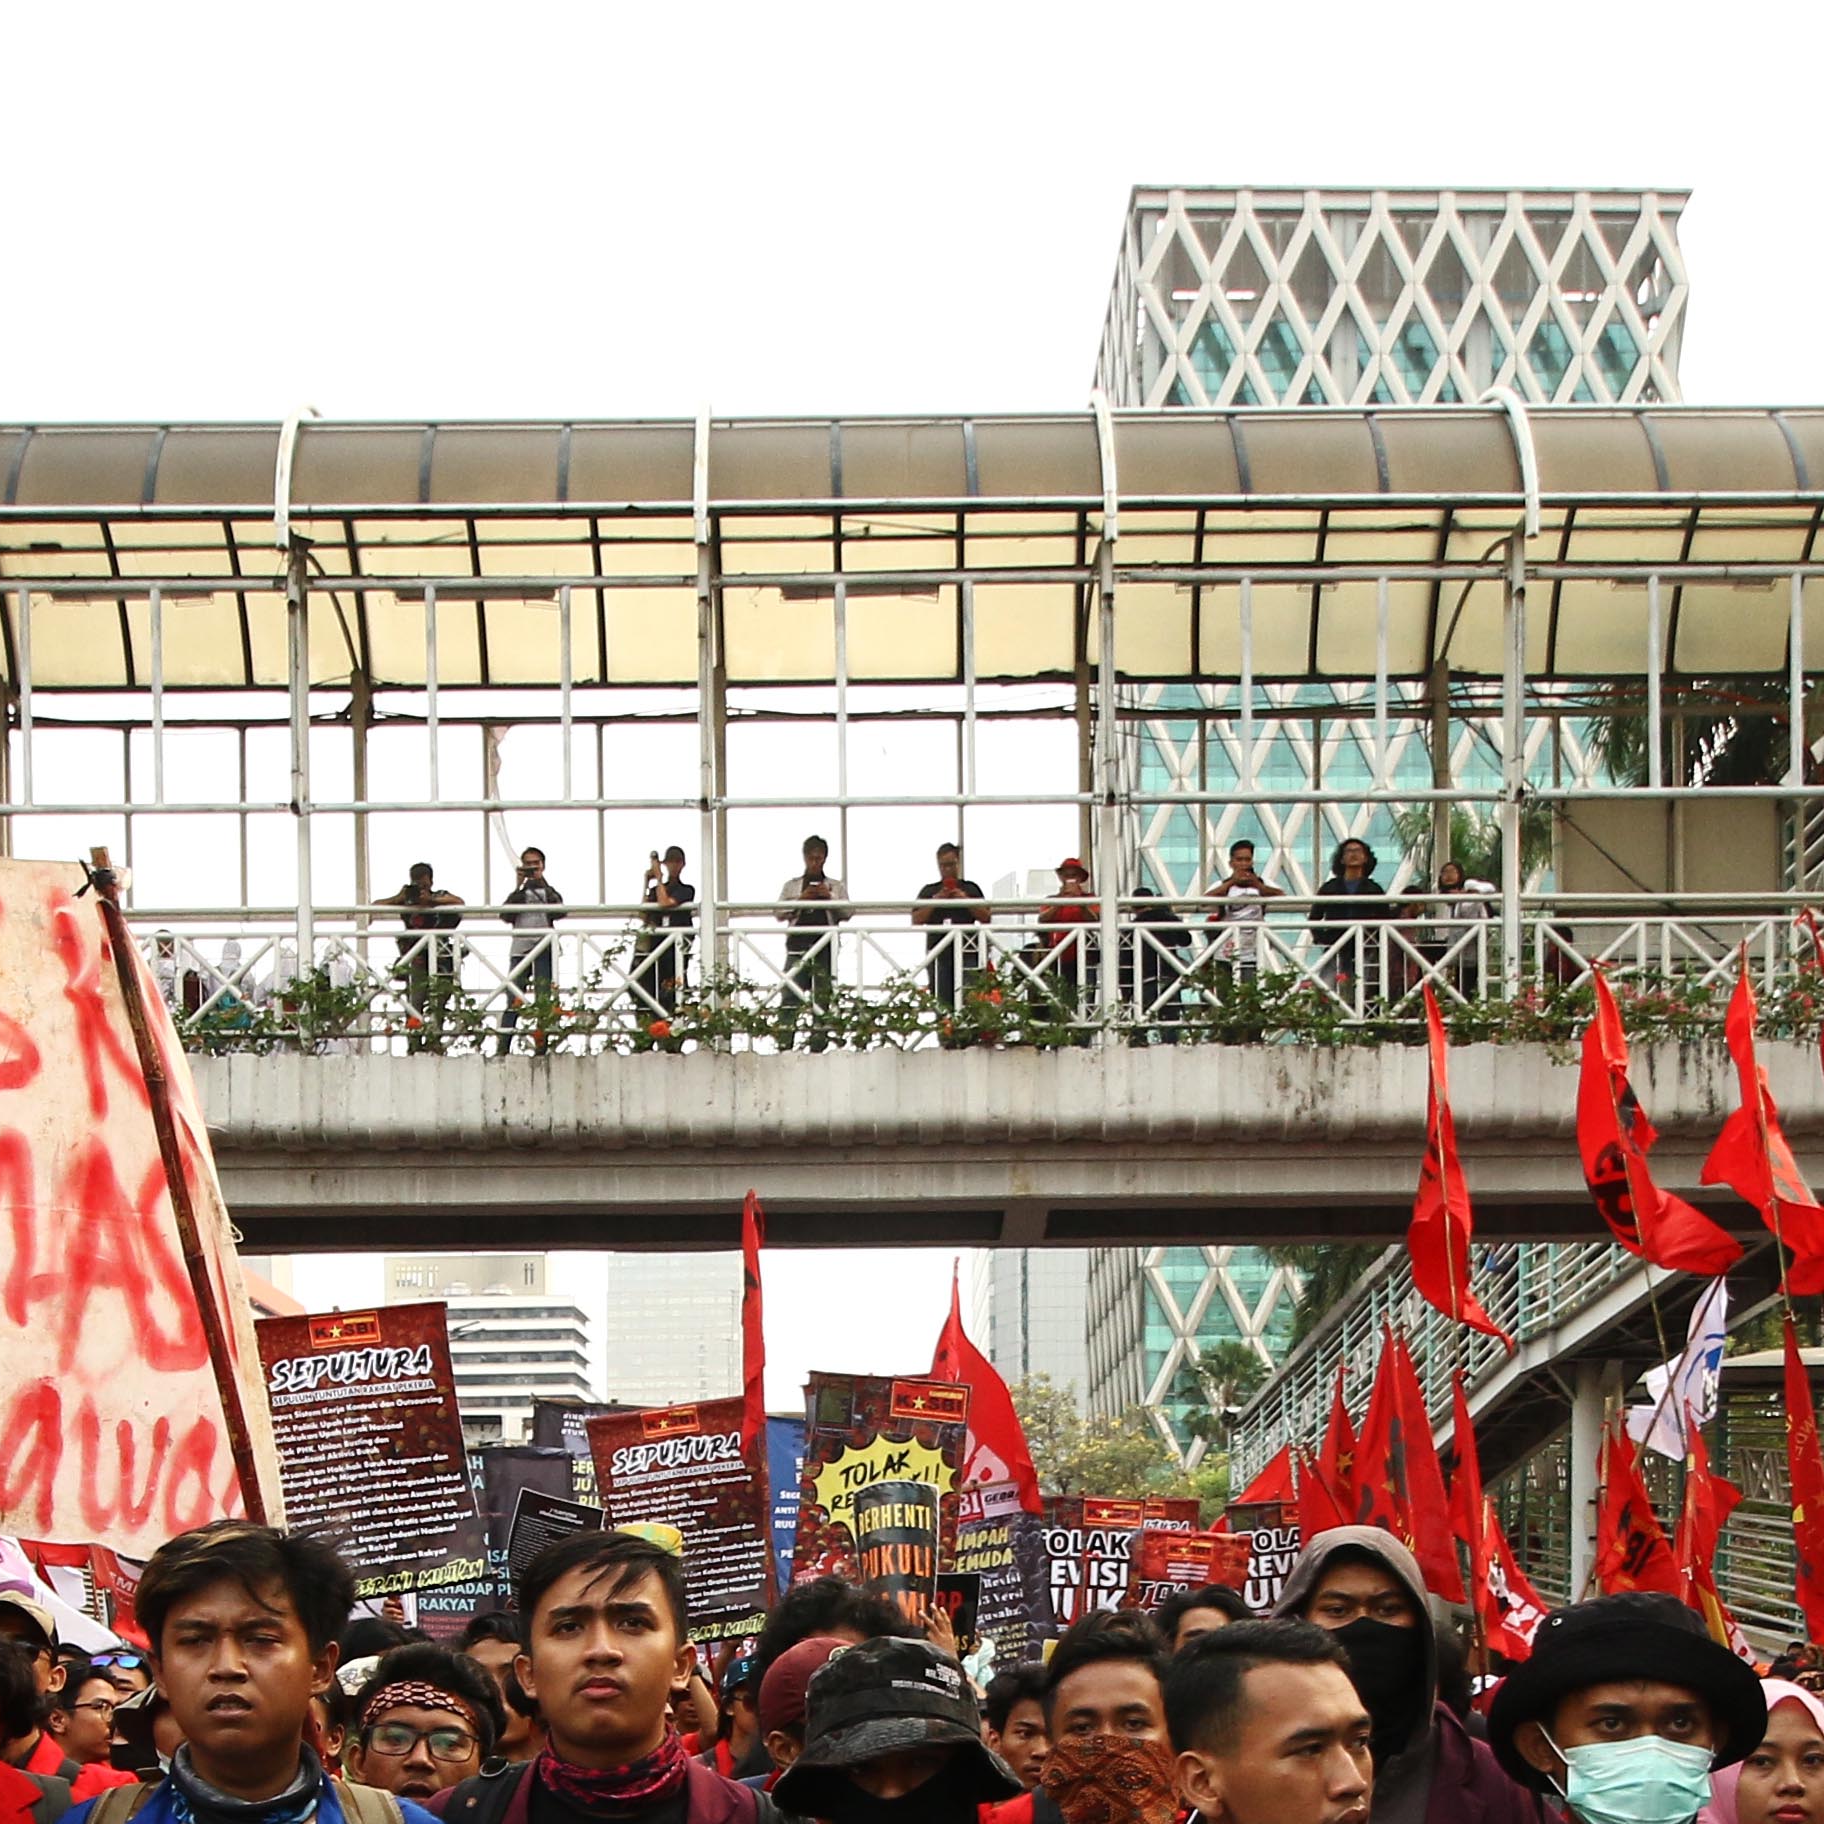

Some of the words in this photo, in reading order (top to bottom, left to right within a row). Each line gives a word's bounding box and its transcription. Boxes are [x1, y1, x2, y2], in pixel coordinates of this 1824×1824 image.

[269, 1344, 433, 1393] SEPULTURA
[272, 1392, 313, 1406] SEPULUH
[314, 1387, 361, 1401] TUNTUTAN
[398, 1379, 435, 1392] PEKERJA
[294, 1409, 320, 1419] Sistem
[323, 1406, 345, 1416] Kerja
[610, 1432, 742, 1476] SEPULTURA
[839, 1449, 911, 1489] TOLAK
[859, 1503, 931, 1536] BERHENTI
[862, 1544, 930, 1579] PUKULI
[982, 1573, 1022, 1589] Revisi
[418, 1598, 476, 1612] RAKYAT
